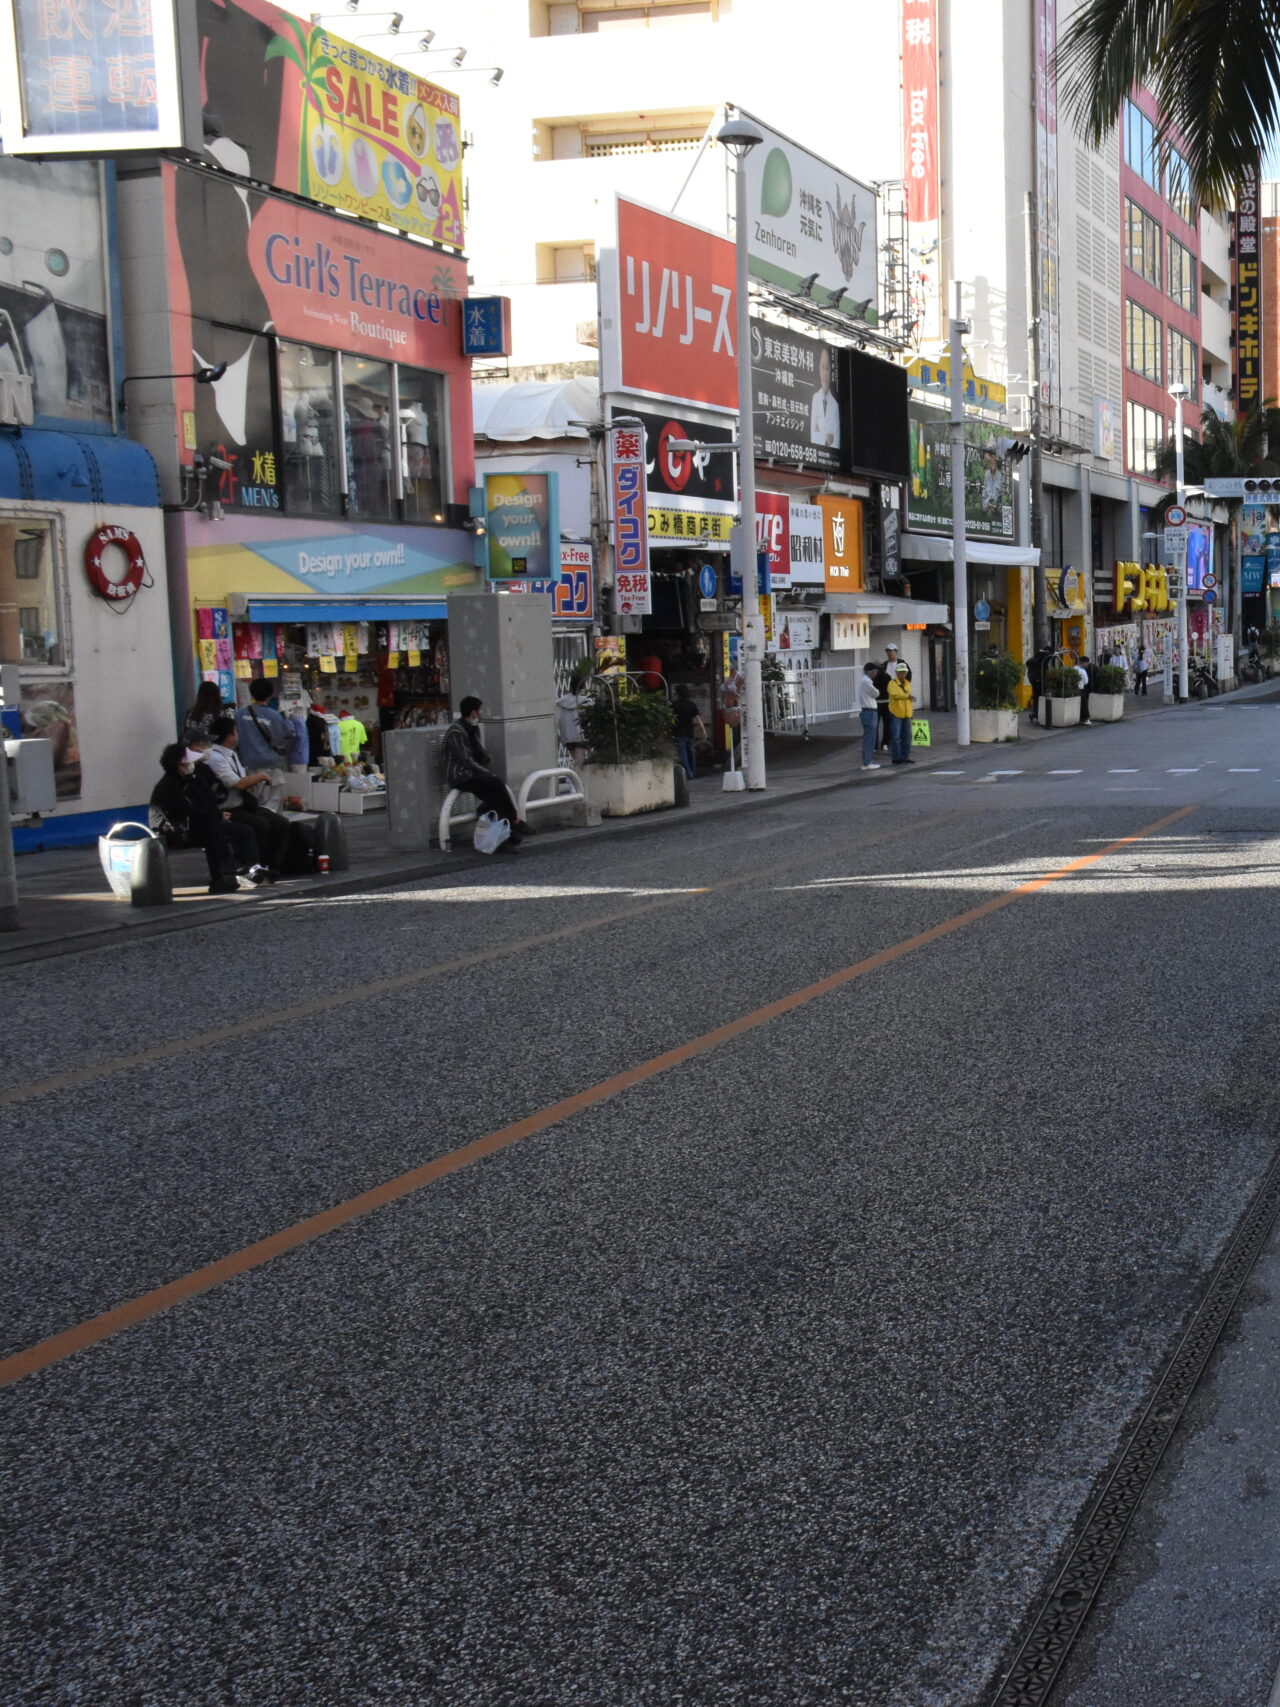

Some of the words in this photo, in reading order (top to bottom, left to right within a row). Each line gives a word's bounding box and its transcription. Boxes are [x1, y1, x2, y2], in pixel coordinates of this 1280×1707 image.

[41, 54, 158, 112] 運転
[325, 65, 400, 138] SALE
[910, 88, 927, 126] Tax
[910, 132, 928, 179] Free
[442, 202, 461, 241] 2F
[799, 189, 823, 220] 沖縄を
[754, 221, 798, 259] Zenhoren
[799, 212, 824, 243] 元気に
[265, 233, 341, 298] Girl's
[343, 254, 440, 325] Terrace
[626, 255, 735, 357] リノリース
[350, 311, 408, 348] Boutique
[468, 306, 487, 346] 水着
[1238, 262, 1259, 399] ドン・キホーテ
[764, 337, 815, 373] 東京美容外科
[921, 364, 989, 402] 市場通り
[765, 411, 805, 432] アンチエイジング
[616, 430, 641, 460] 薬
[771, 440, 818, 463] 0120-658-958
[252, 450, 276, 485] 水着
[241, 486, 279, 508] MEN's
[493, 491, 542, 507] Design
[502, 514, 535, 528] your
[617, 466, 641, 567] ダイコク
[648, 512, 721, 537] つみ橋商店街
[499, 532, 541, 547] own!!
[561, 548, 590, 562] x-Free
[299, 551, 342, 578] Design
[345, 550, 371, 572] your
[373, 543, 405, 566] own!!
[531, 571, 589, 614] イコク
[617, 574, 648, 593] 免税
